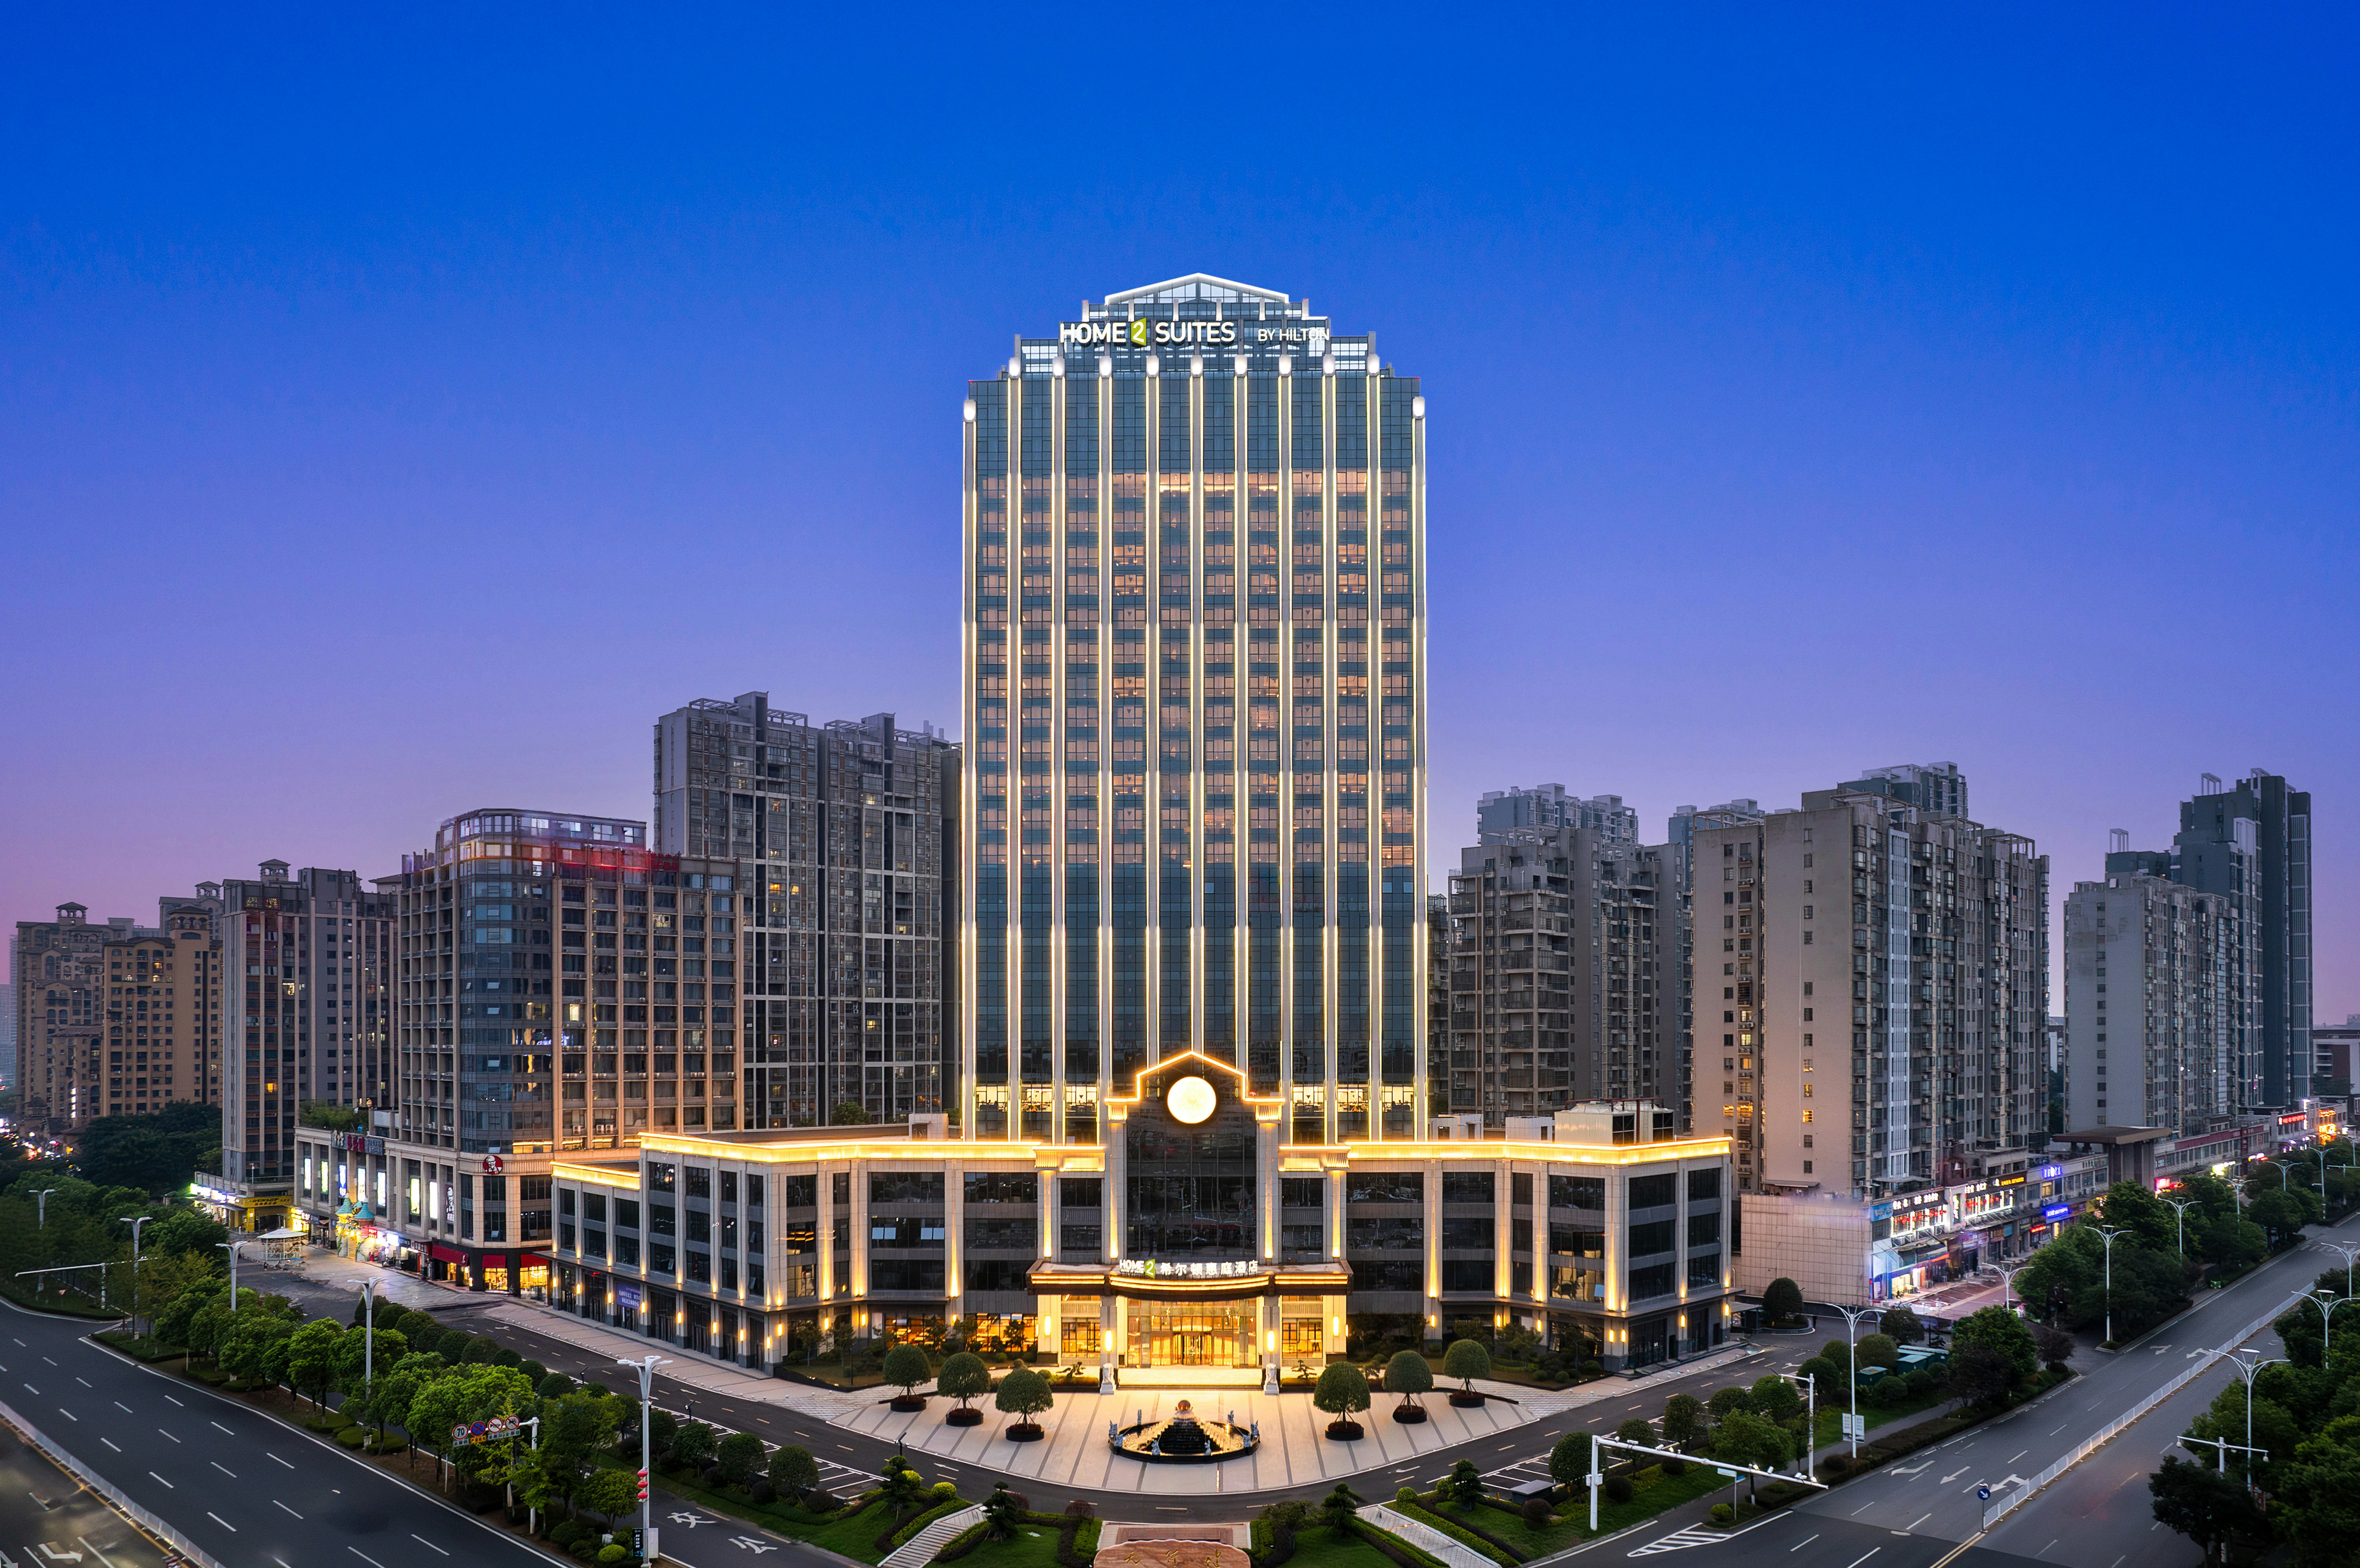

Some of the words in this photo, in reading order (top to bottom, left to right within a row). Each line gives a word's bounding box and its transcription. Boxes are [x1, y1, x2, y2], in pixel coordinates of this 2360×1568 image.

[1060, 322, 1127, 343] HOME
[1155, 322, 1235, 343] SUITES
[1258, 328, 1276, 341] BY
[1279, 328, 1329, 341] HILTON
[1119, 1259, 1145, 1270] HOME
[1160, 1260, 1259, 1276] 希尔顿惠庭酒店
[457, 1428, 465, 1437] 70
